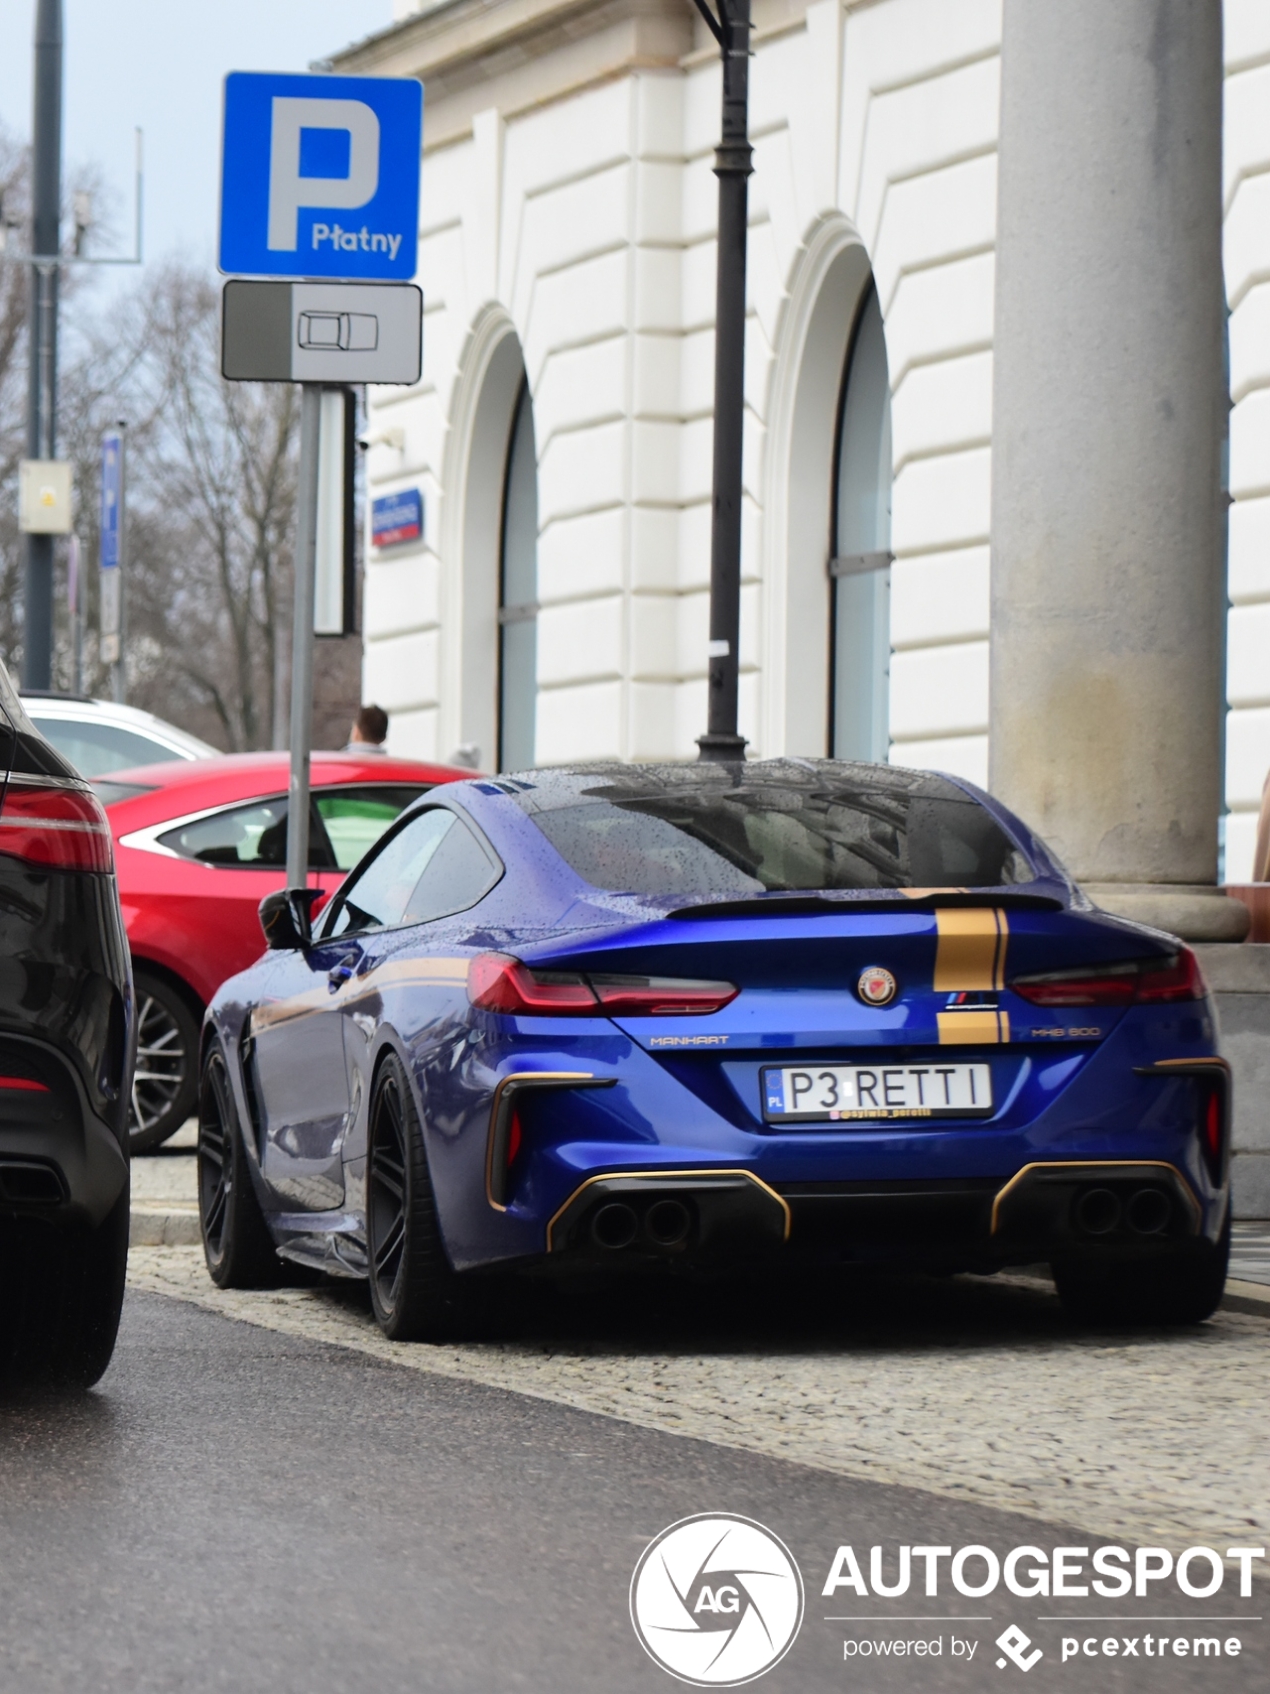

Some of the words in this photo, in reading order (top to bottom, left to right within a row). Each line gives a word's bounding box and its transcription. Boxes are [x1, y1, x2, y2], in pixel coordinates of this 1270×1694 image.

[267, 96, 380, 251] P
[312, 223, 403, 261] Płatny
[650, 1035, 729, 1046] MANHART
[768, 1096, 783, 1108] PL
[790, 1072, 839, 1109] P3
[856, 1068, 977, 1108] RETTI
